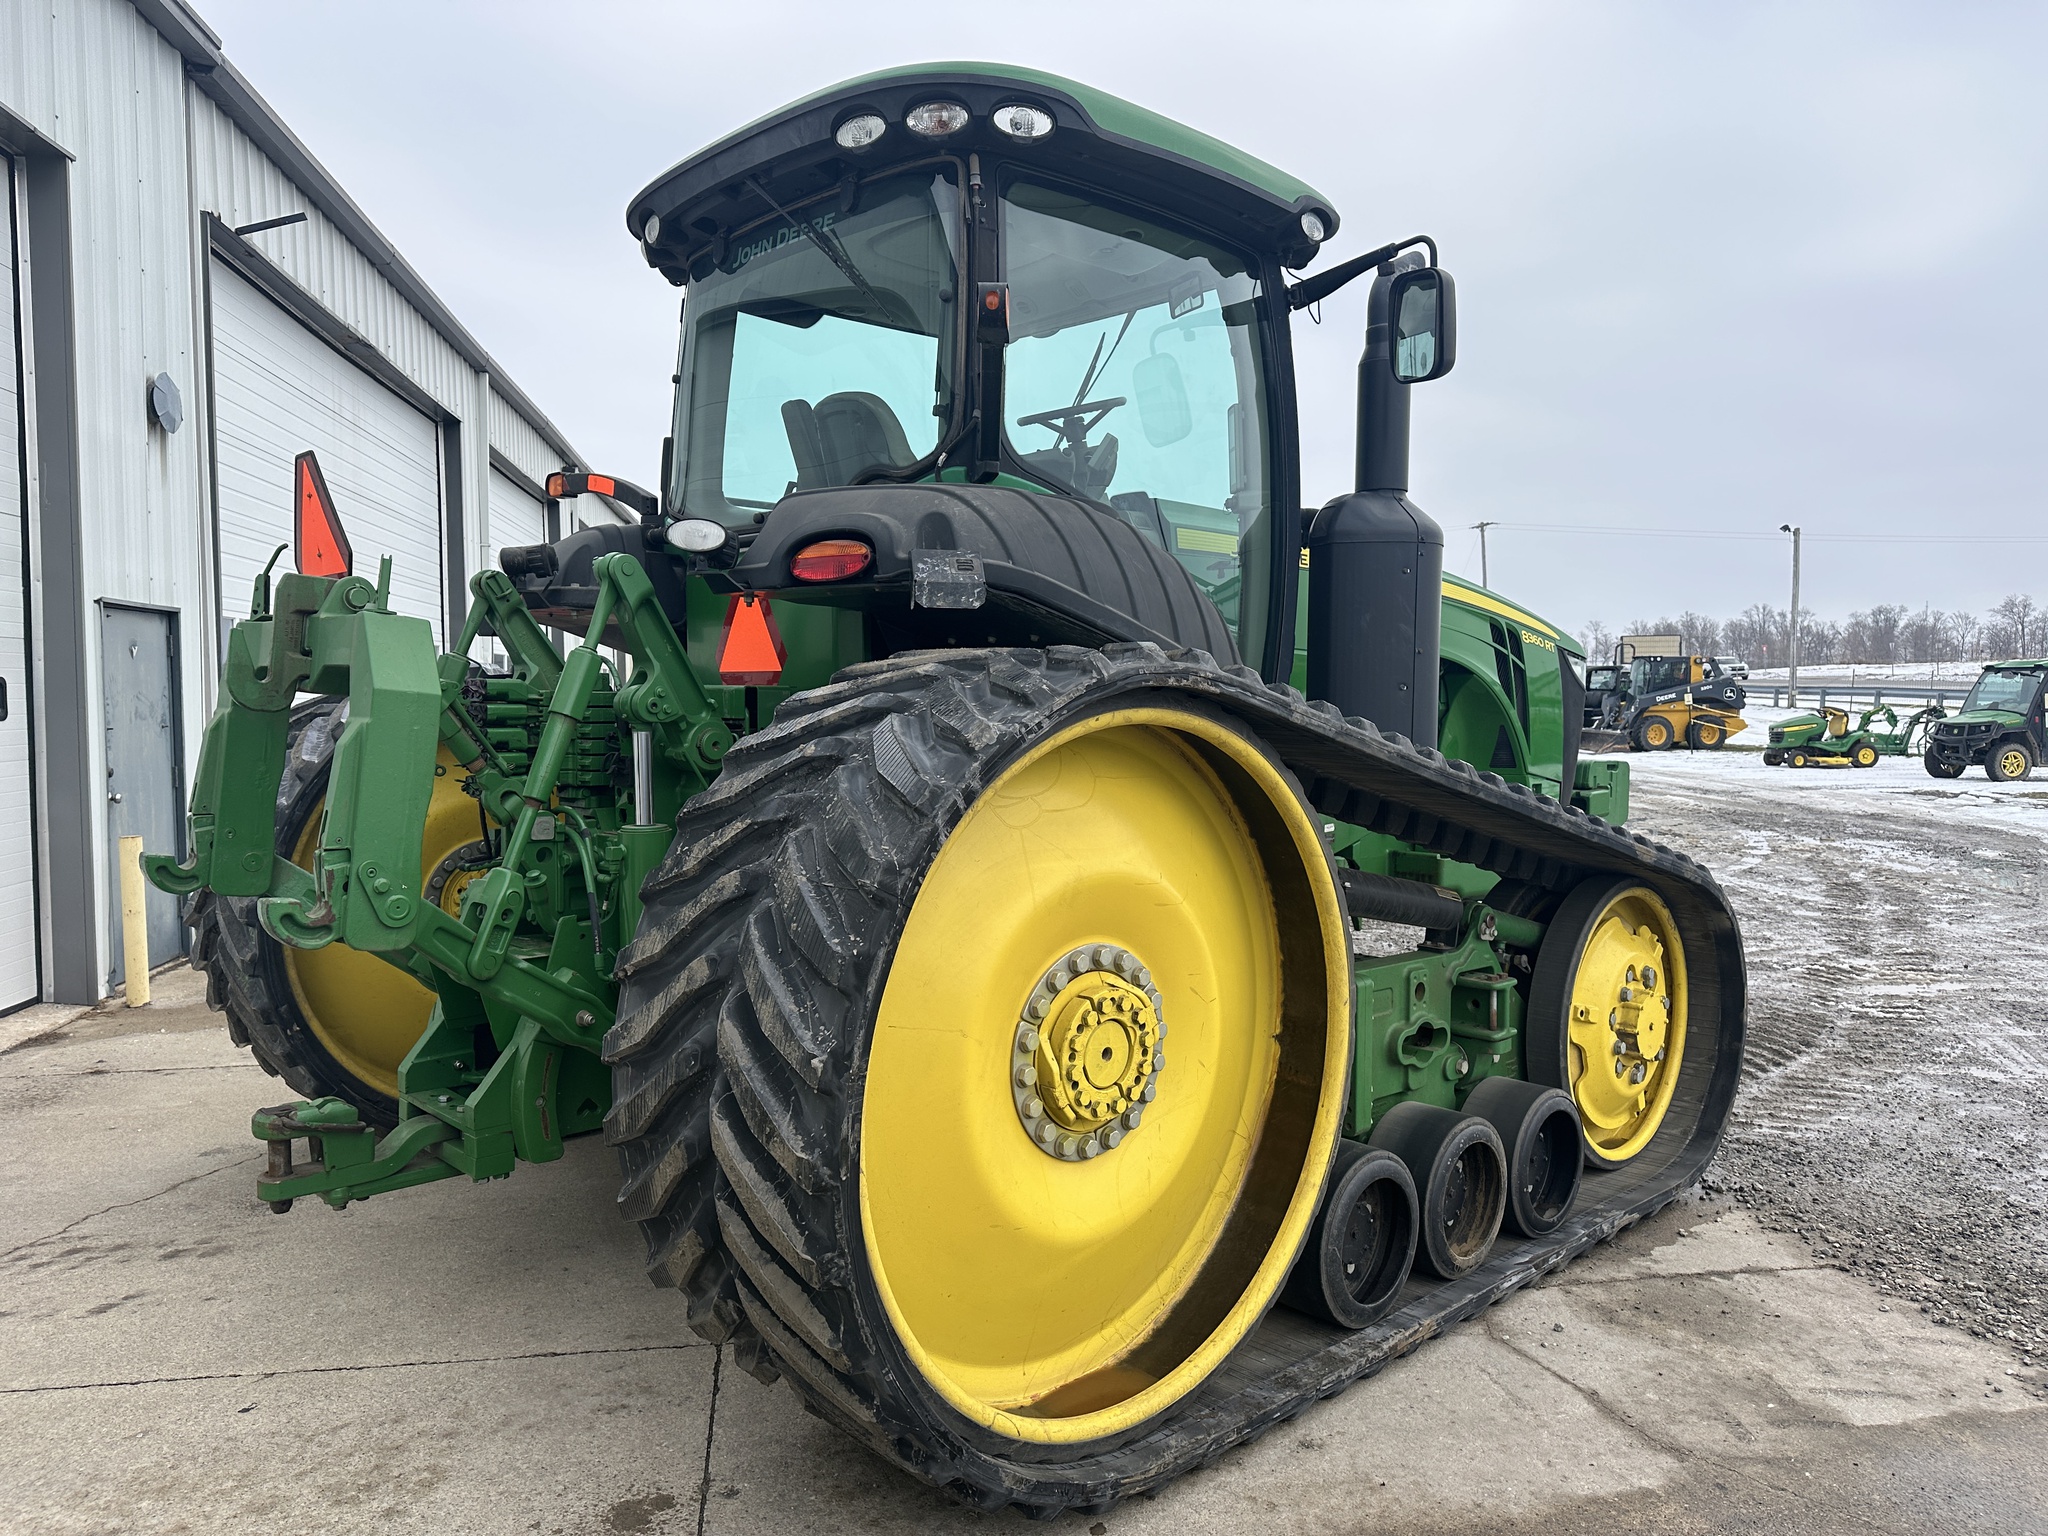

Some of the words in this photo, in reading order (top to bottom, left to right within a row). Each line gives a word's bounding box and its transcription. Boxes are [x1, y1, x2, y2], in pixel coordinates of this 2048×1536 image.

[732, 236, 773, 269] JOHN
[776, 212, 836, 249] DEERE
[1521, 630, 1544, 648] 8360
[1544, 639, 1555, 653] RT
[1655, 692, 1677, 702] DEERE
